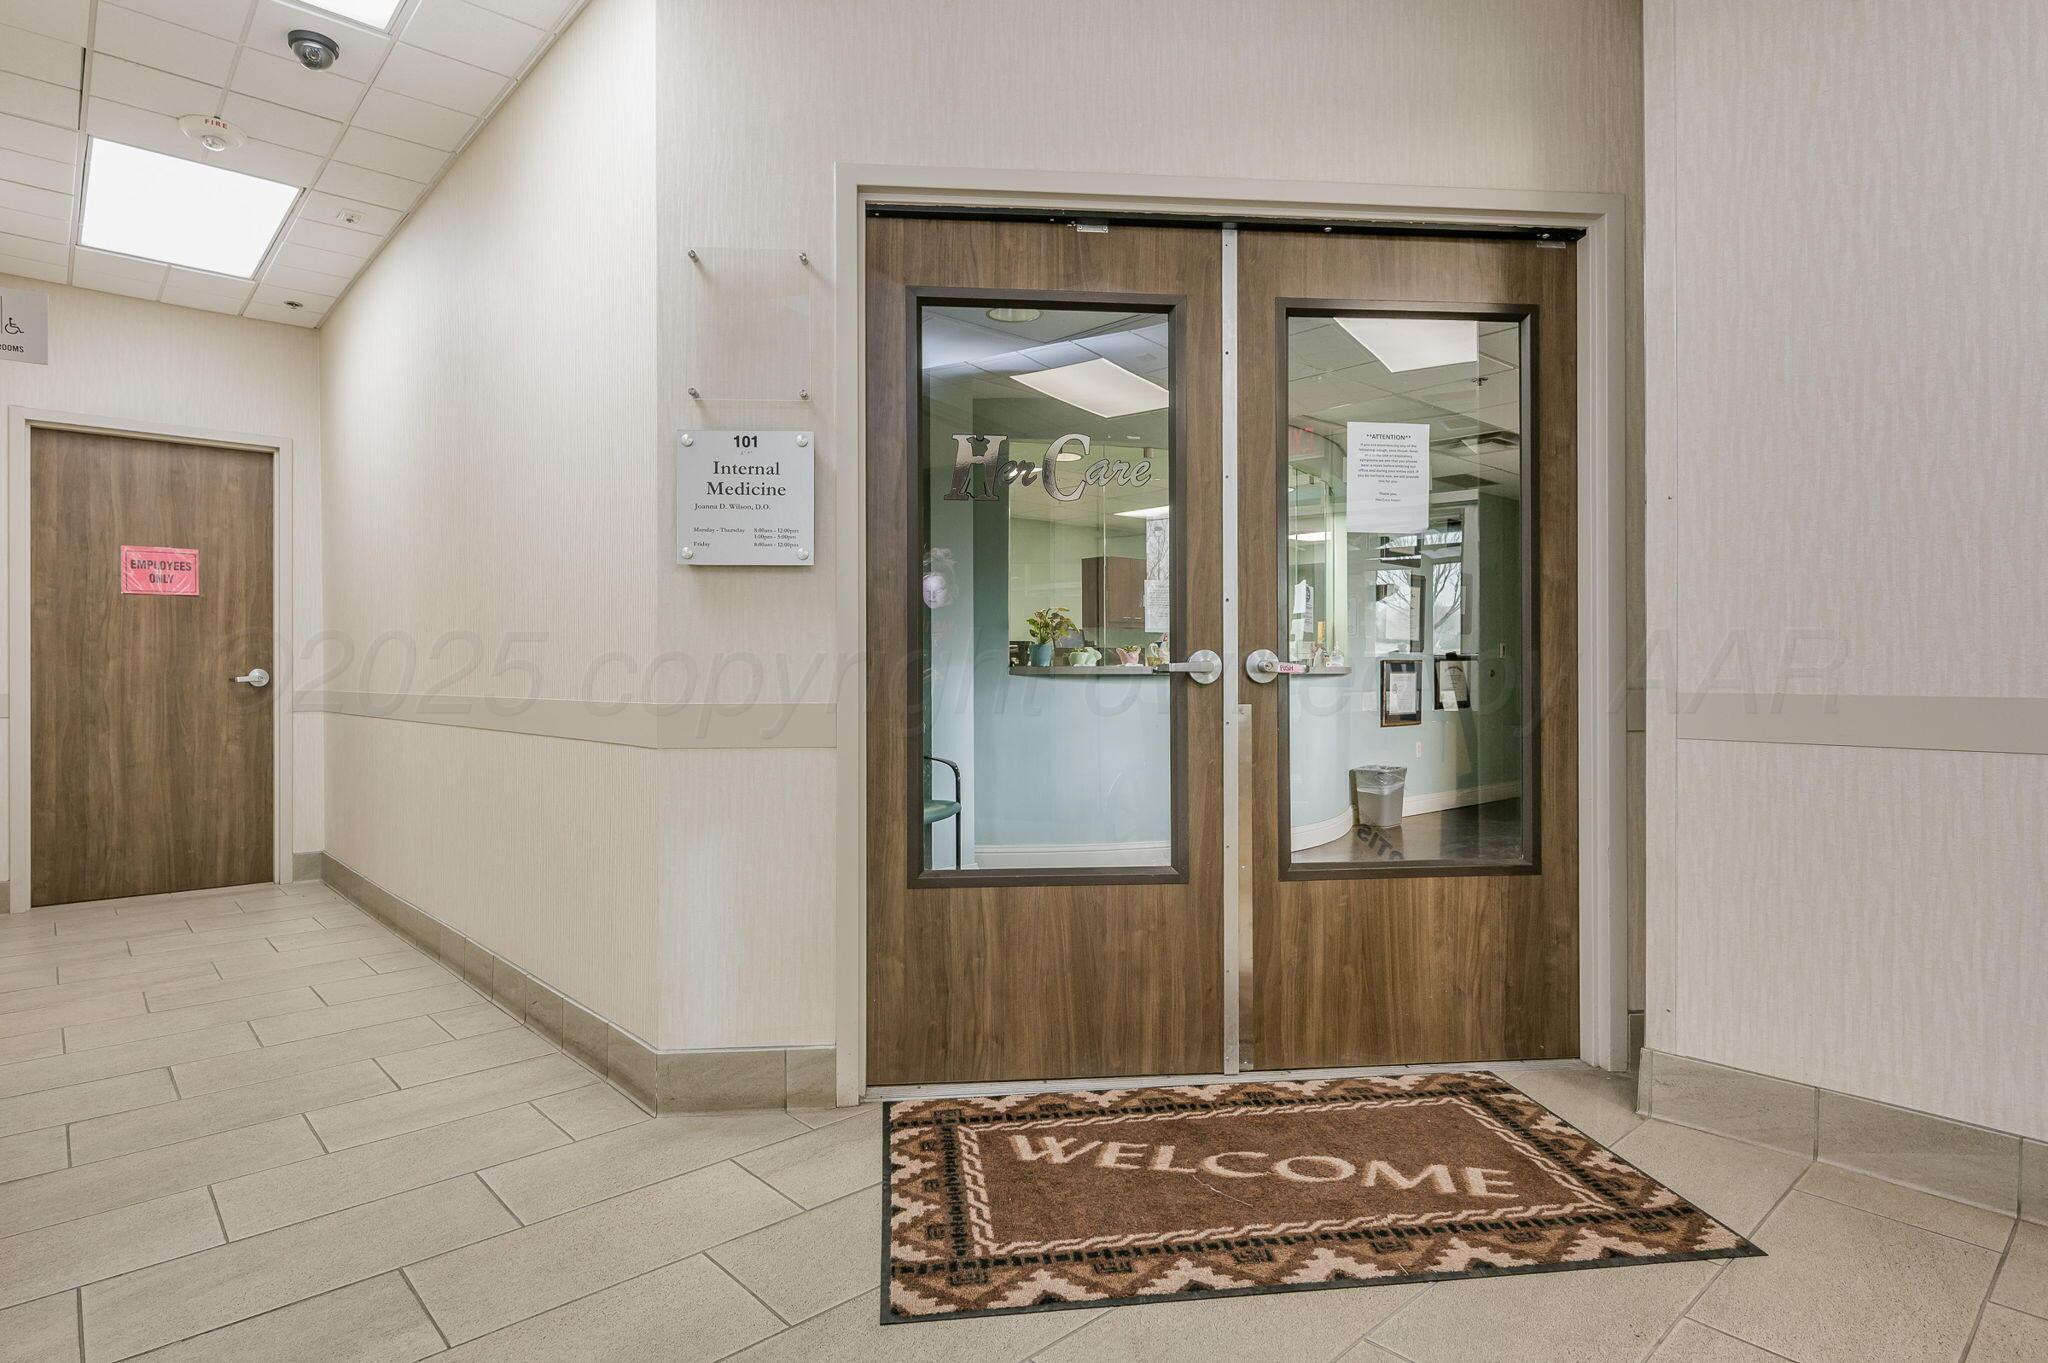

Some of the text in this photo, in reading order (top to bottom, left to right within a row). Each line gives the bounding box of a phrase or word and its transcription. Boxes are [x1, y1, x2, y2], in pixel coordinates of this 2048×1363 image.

[204, 118, 228, 129] FIRE
[733, 435, 758, 448] 101
[712, 460, 781, 475] Internal
[944, 433, 1151, 502] Her Care
[706, 481, 787, 496] Medicine
[694, 503, 718, 511] Joanna
[130, 559, 192, 572] EMPLOYEES
[149, 573, 175, 584] ONLY
[1007, 1133, 1520, 1198] WELCOME
